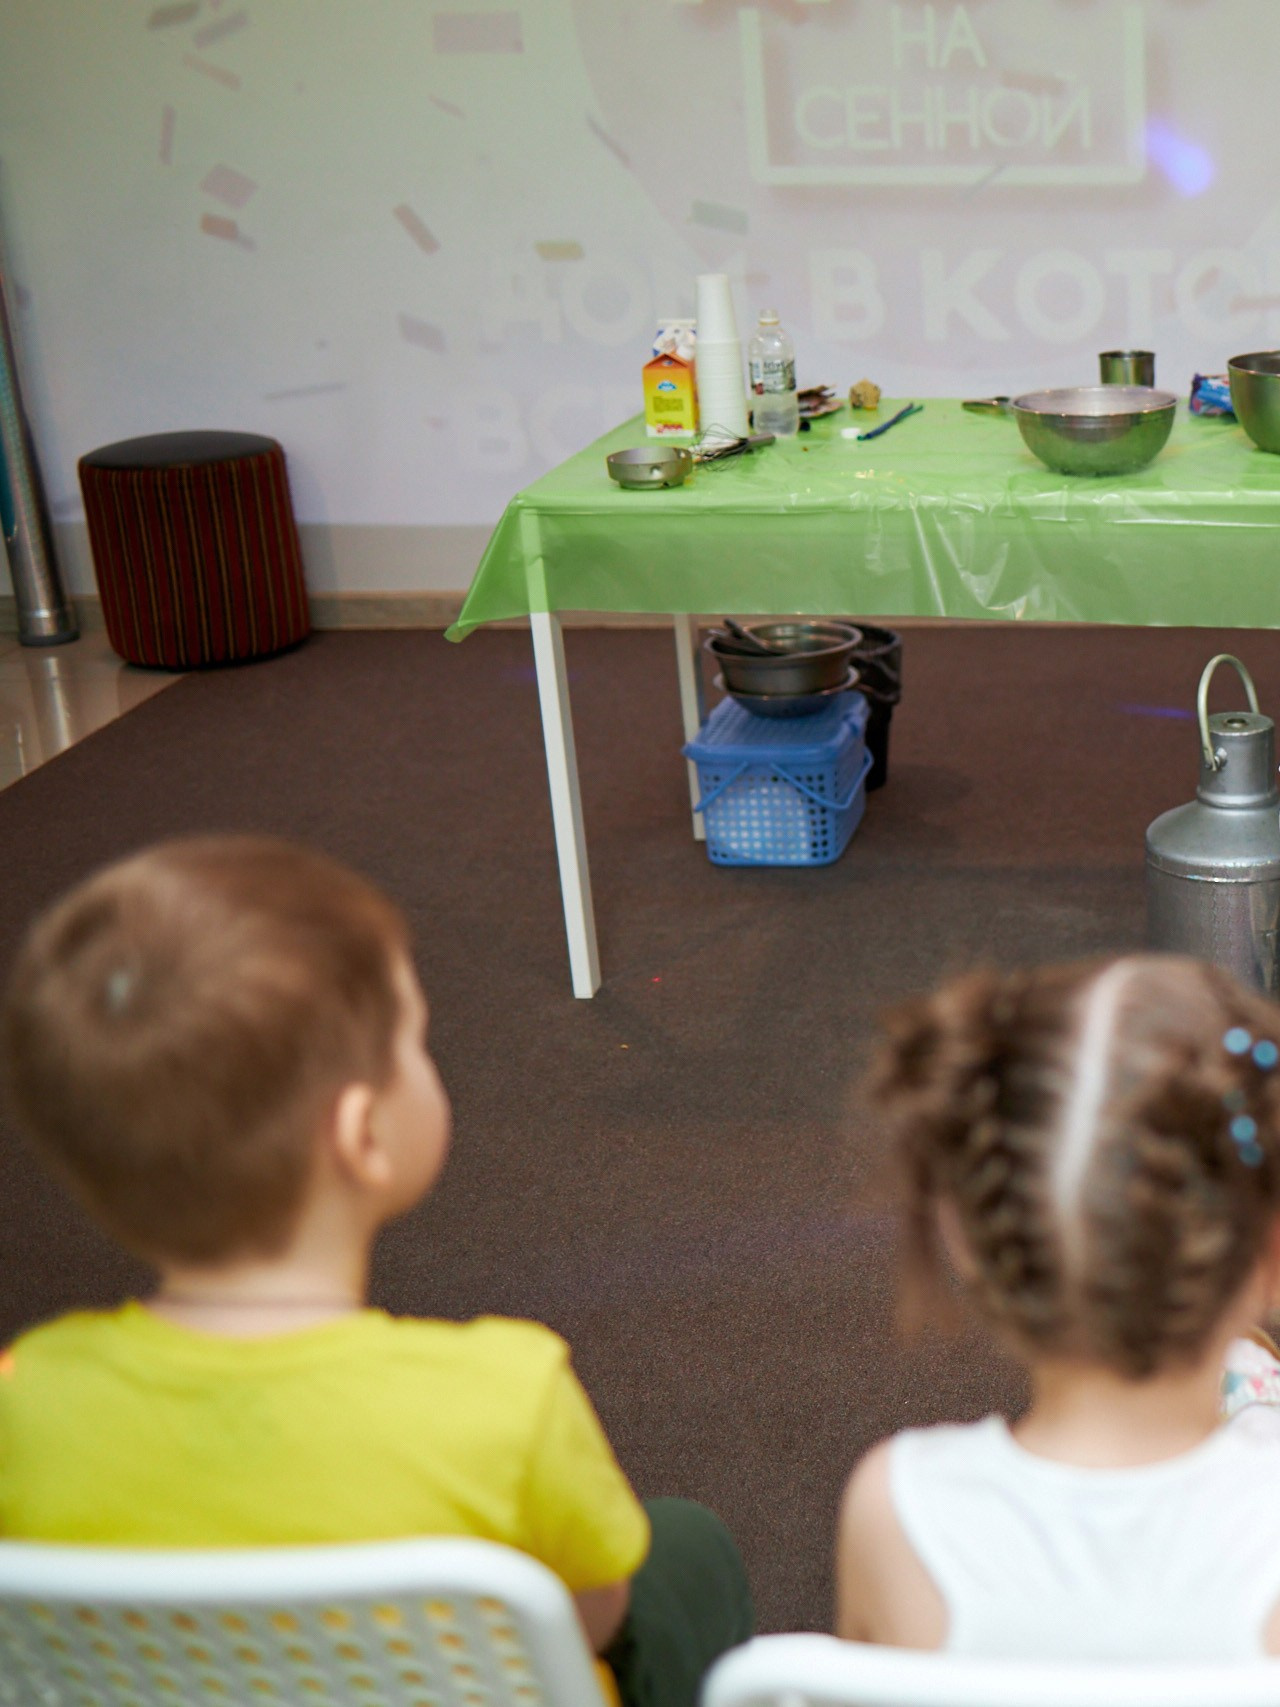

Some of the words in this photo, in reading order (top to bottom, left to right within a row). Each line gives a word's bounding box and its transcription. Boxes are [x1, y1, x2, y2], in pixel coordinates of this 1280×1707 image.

[891, 4, 987, 69] НА
[795, 71, 1093, 151] СЕННОЙ
[807, 247, 887, 342] В
